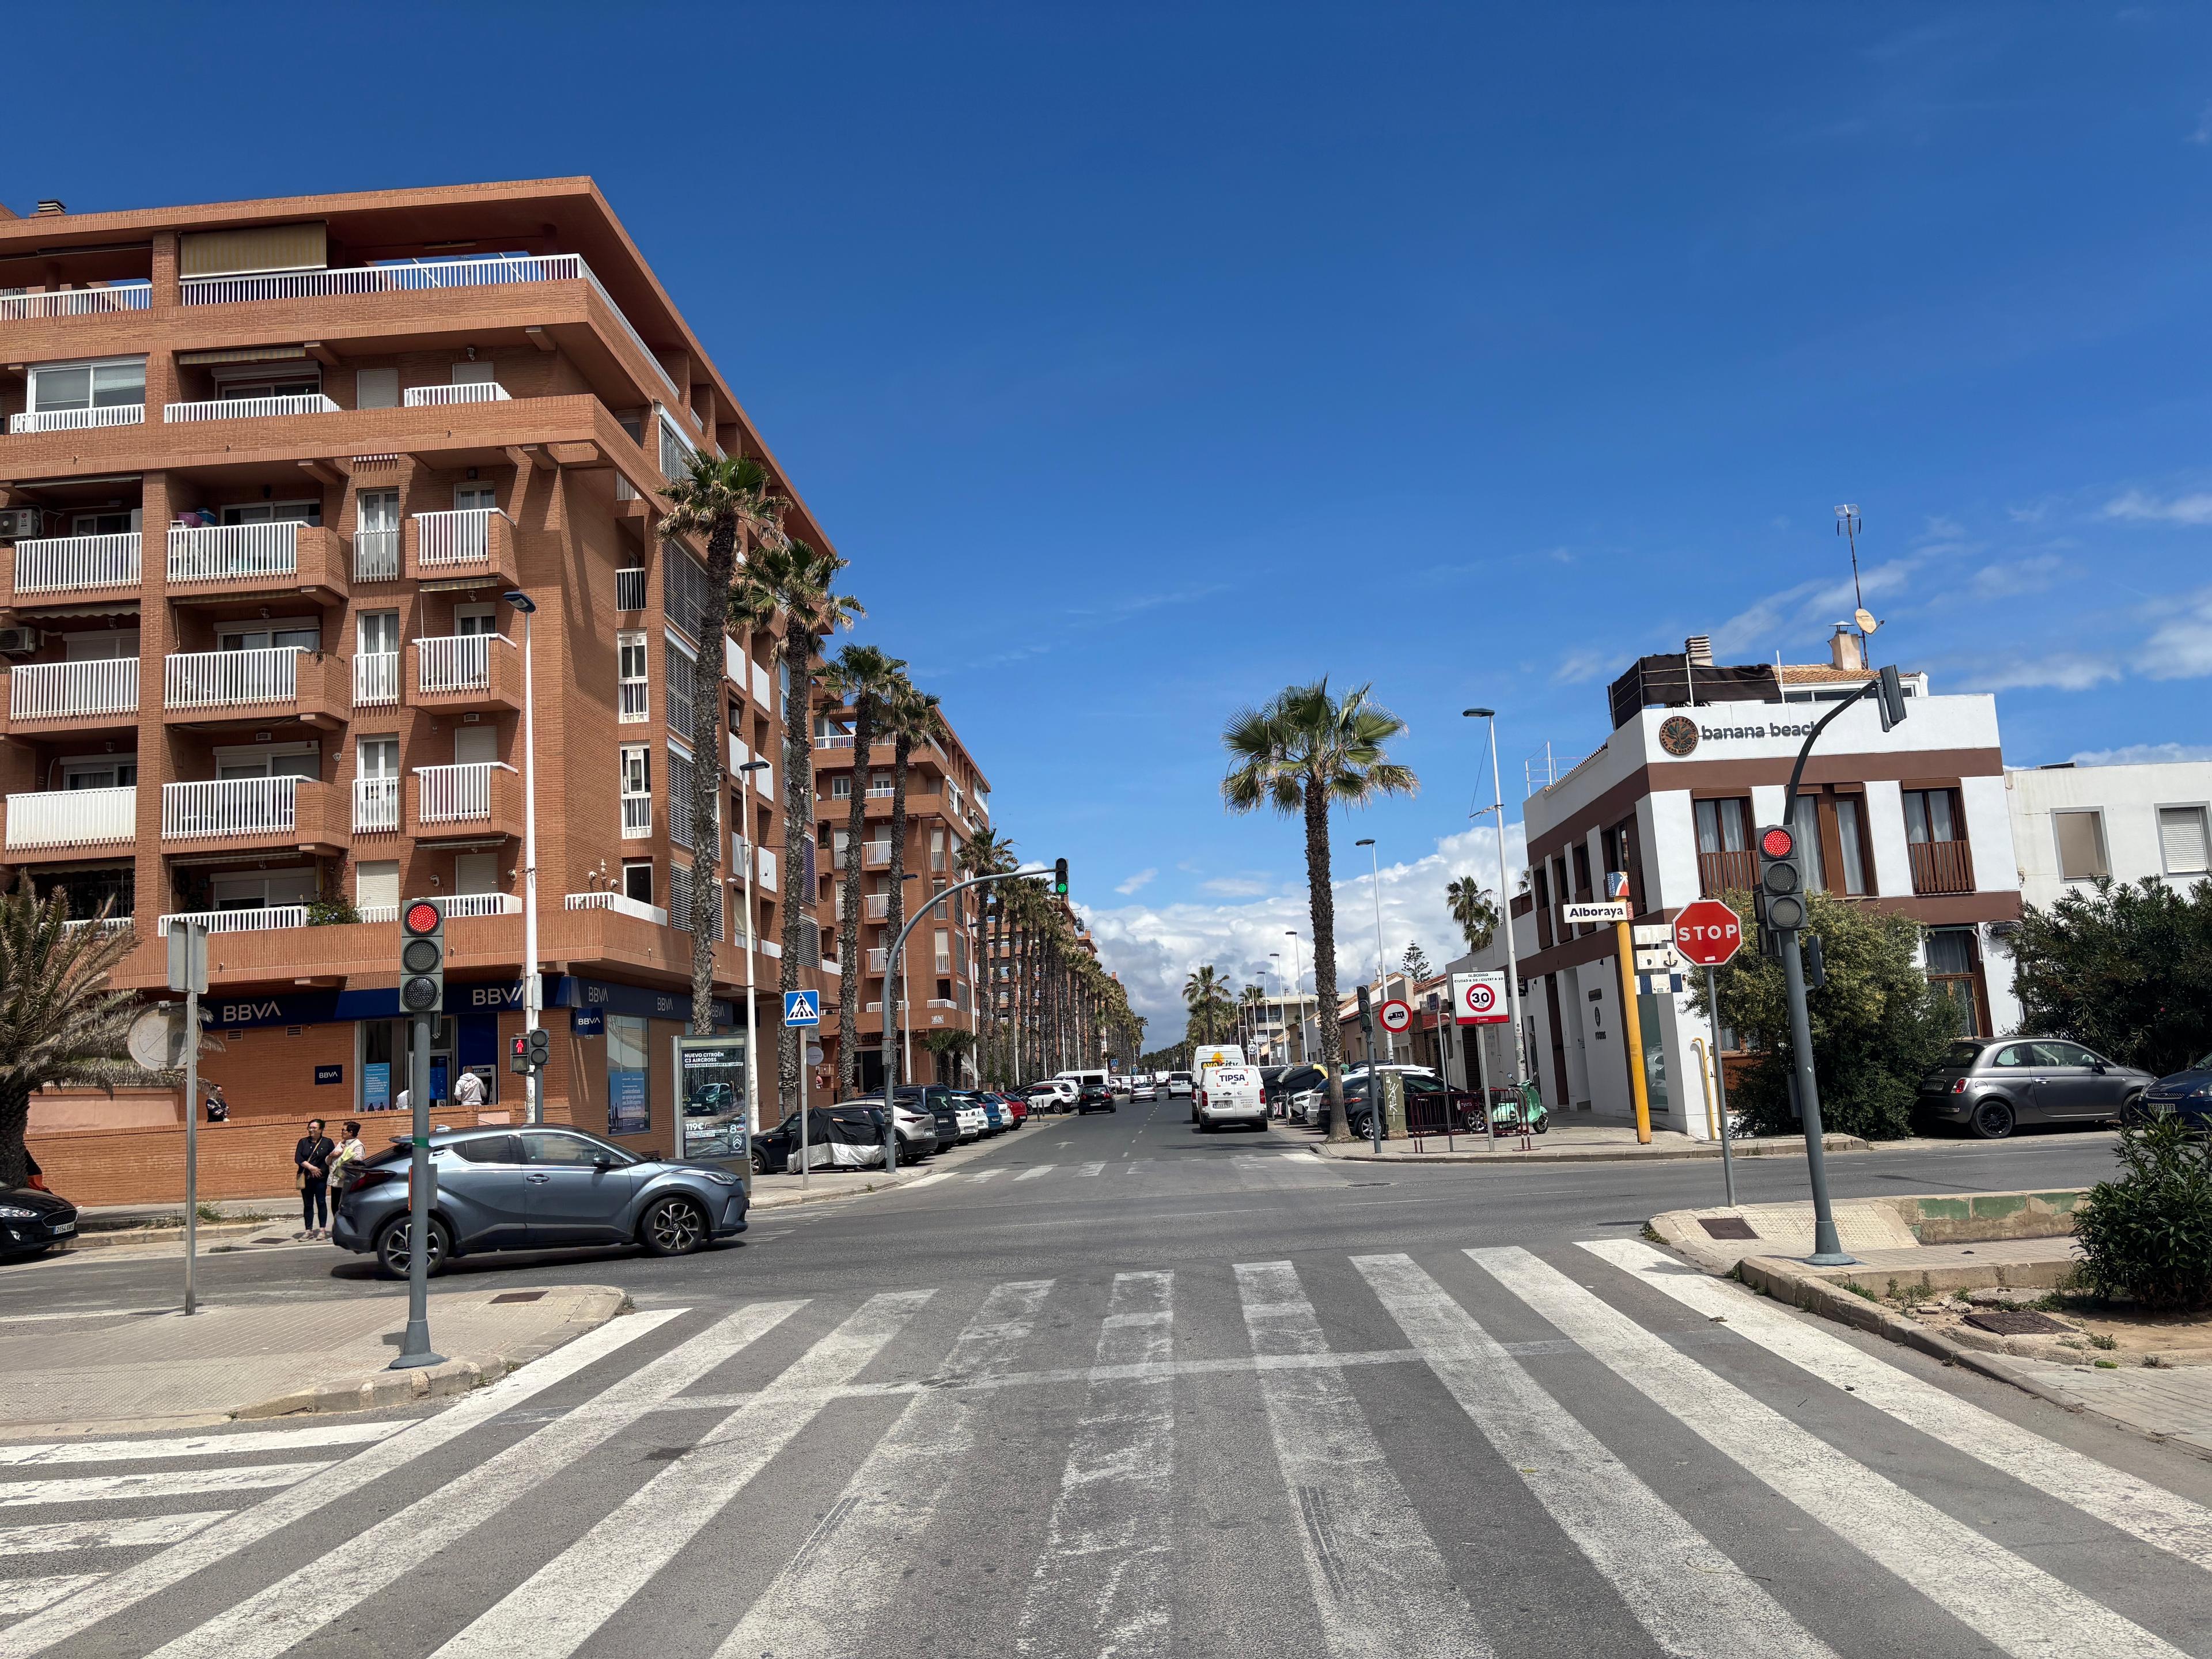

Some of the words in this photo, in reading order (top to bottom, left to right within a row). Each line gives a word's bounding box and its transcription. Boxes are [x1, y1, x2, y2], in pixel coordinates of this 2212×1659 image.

[1702, 725, 1766, 740] banana
[1569, 907, 1624, 918] Alboraya
[1679, 924, 1737, 941] STOP
[588, 986, 609, 1003] BBVA
[1472, 992, 1490, 1003] 30
[223, 1001, 282, 1022] BBVA
[657, 997, 673, 1012] BBVA
[578, 1017, 600, 1025] BBVA
[729, 1124, 737, 1133] 8
